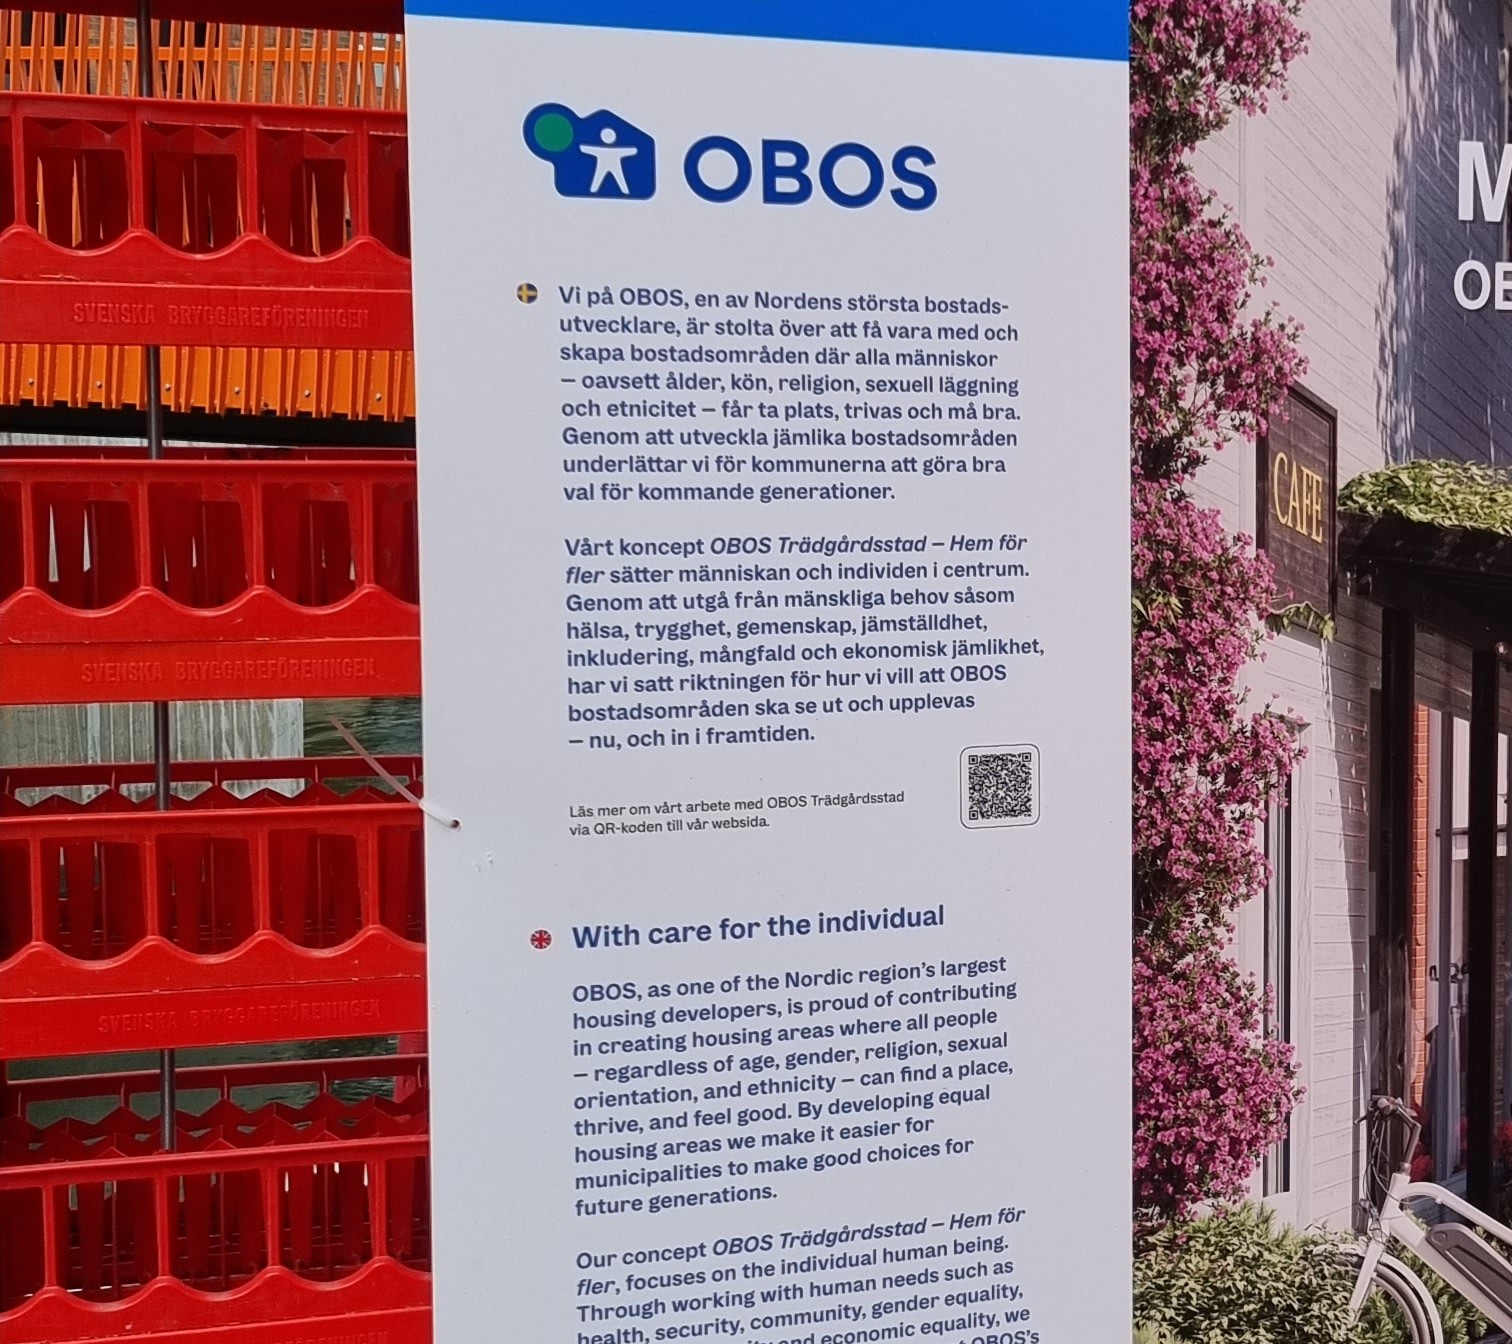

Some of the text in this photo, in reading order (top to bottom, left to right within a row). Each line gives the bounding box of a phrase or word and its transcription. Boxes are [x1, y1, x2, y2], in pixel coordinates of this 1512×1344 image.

[683, 135, 938, 212] OBOS
[558, 285, 1009, 315] Vi på OBOS, en av Nordens största bostads-
[560, 342, 999, 368] skapa bostadsområden där alla människor
[563, 482, 896, 504] val för kommande generationer.
[1272, 451, 1323, 544] CAFE
[569, 790, 905, 818] Läs mer om vårt arbete med OBOS Trädgårdsstad
[569, 815, 770, 836] via QR-koden till vår websida.
[572, 904, 944, 949] With care for the individual
[572, 982, 643, 1003] OBOS,
[647, 984, 672, 998] as
[676, 981, 715, 996] one
[720, 975, 741, 993] of
[746, 974, 780, 992] the
[785, 968, 854, 989] Nordic
[940, 956, 1007, 978] largest
